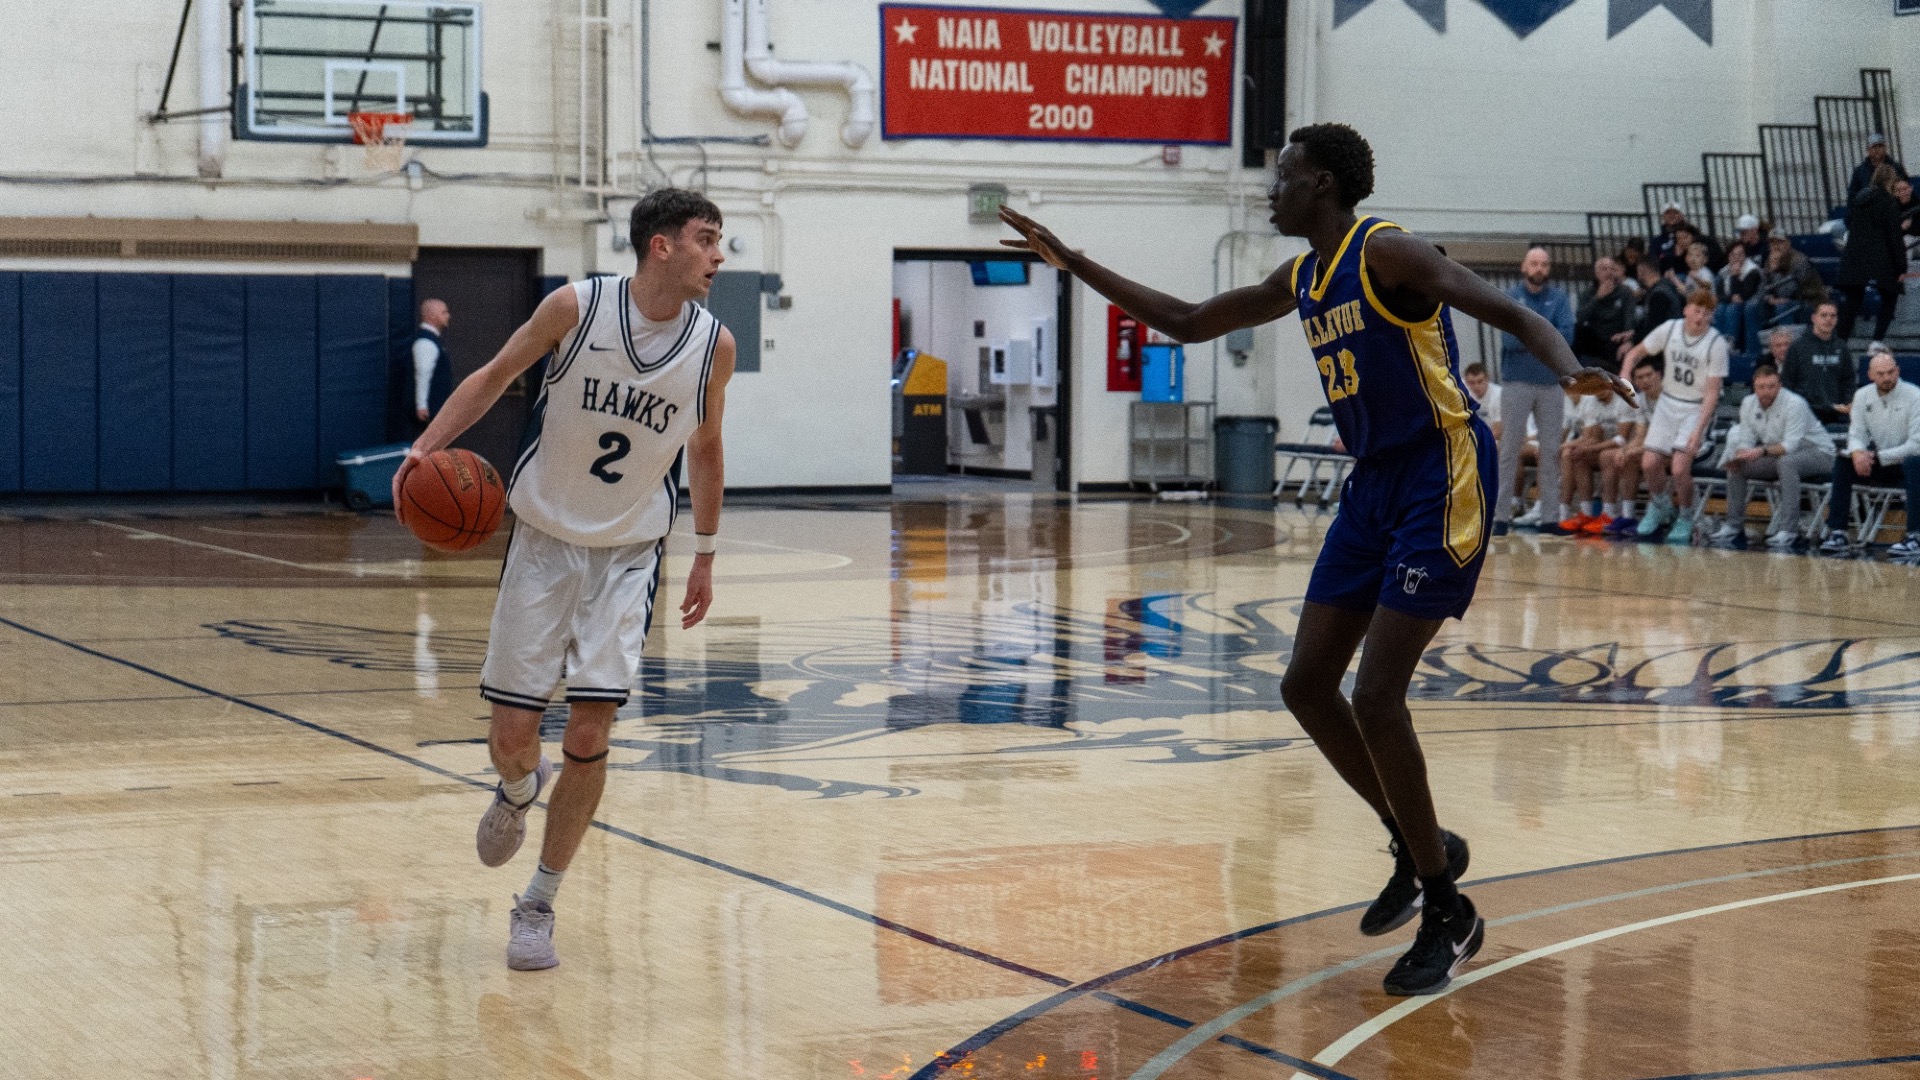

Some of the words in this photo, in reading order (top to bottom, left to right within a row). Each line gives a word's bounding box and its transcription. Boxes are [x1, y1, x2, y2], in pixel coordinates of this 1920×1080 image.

[938, 18, 1001, 50] NAIA
[1028, 21, 1184, 57] VOLLEYBALL
[910, 58, 1034, 94] NATIONAL
[1065, 63, 1208, 98] CHAMPIONS
[1028, 104, 1094, 130] 2000
[1302, 299, 1366, 348] LLEVUE
[1317, 348, 1360, 403] 23
[582, 377, 679, 434] HAWKS
[913, 403, 943, 417] ATM
[589, 431, 631, 484] 2
